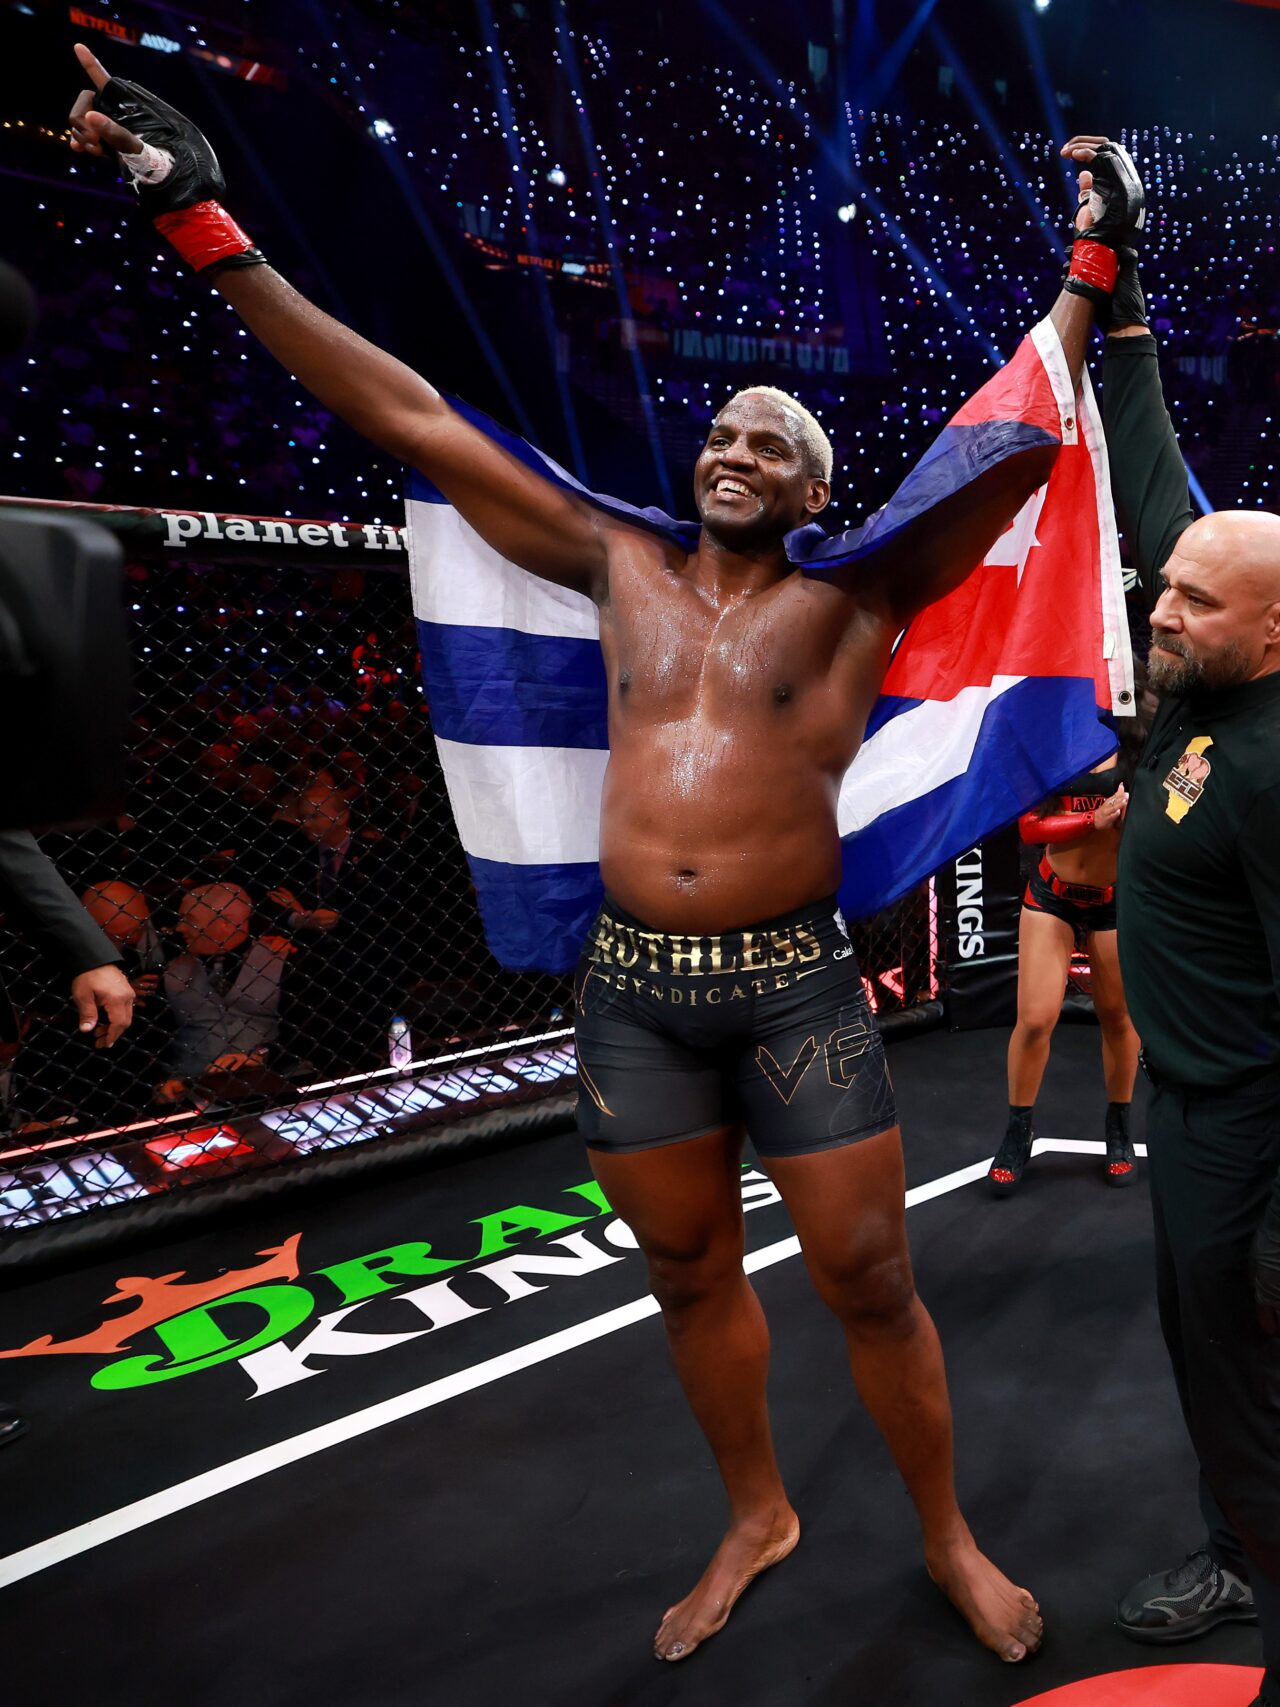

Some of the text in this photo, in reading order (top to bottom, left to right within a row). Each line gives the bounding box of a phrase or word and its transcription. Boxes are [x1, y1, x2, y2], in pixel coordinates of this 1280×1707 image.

[69, 7, 129, 40] NETFLIX
[161, 511, 349, 548] planet
[588, 914, 822, 977] RUTHLESS
[616, 973, 792, 1007] SYNDICATE
[90, 1178, 615, 1391] DRA
